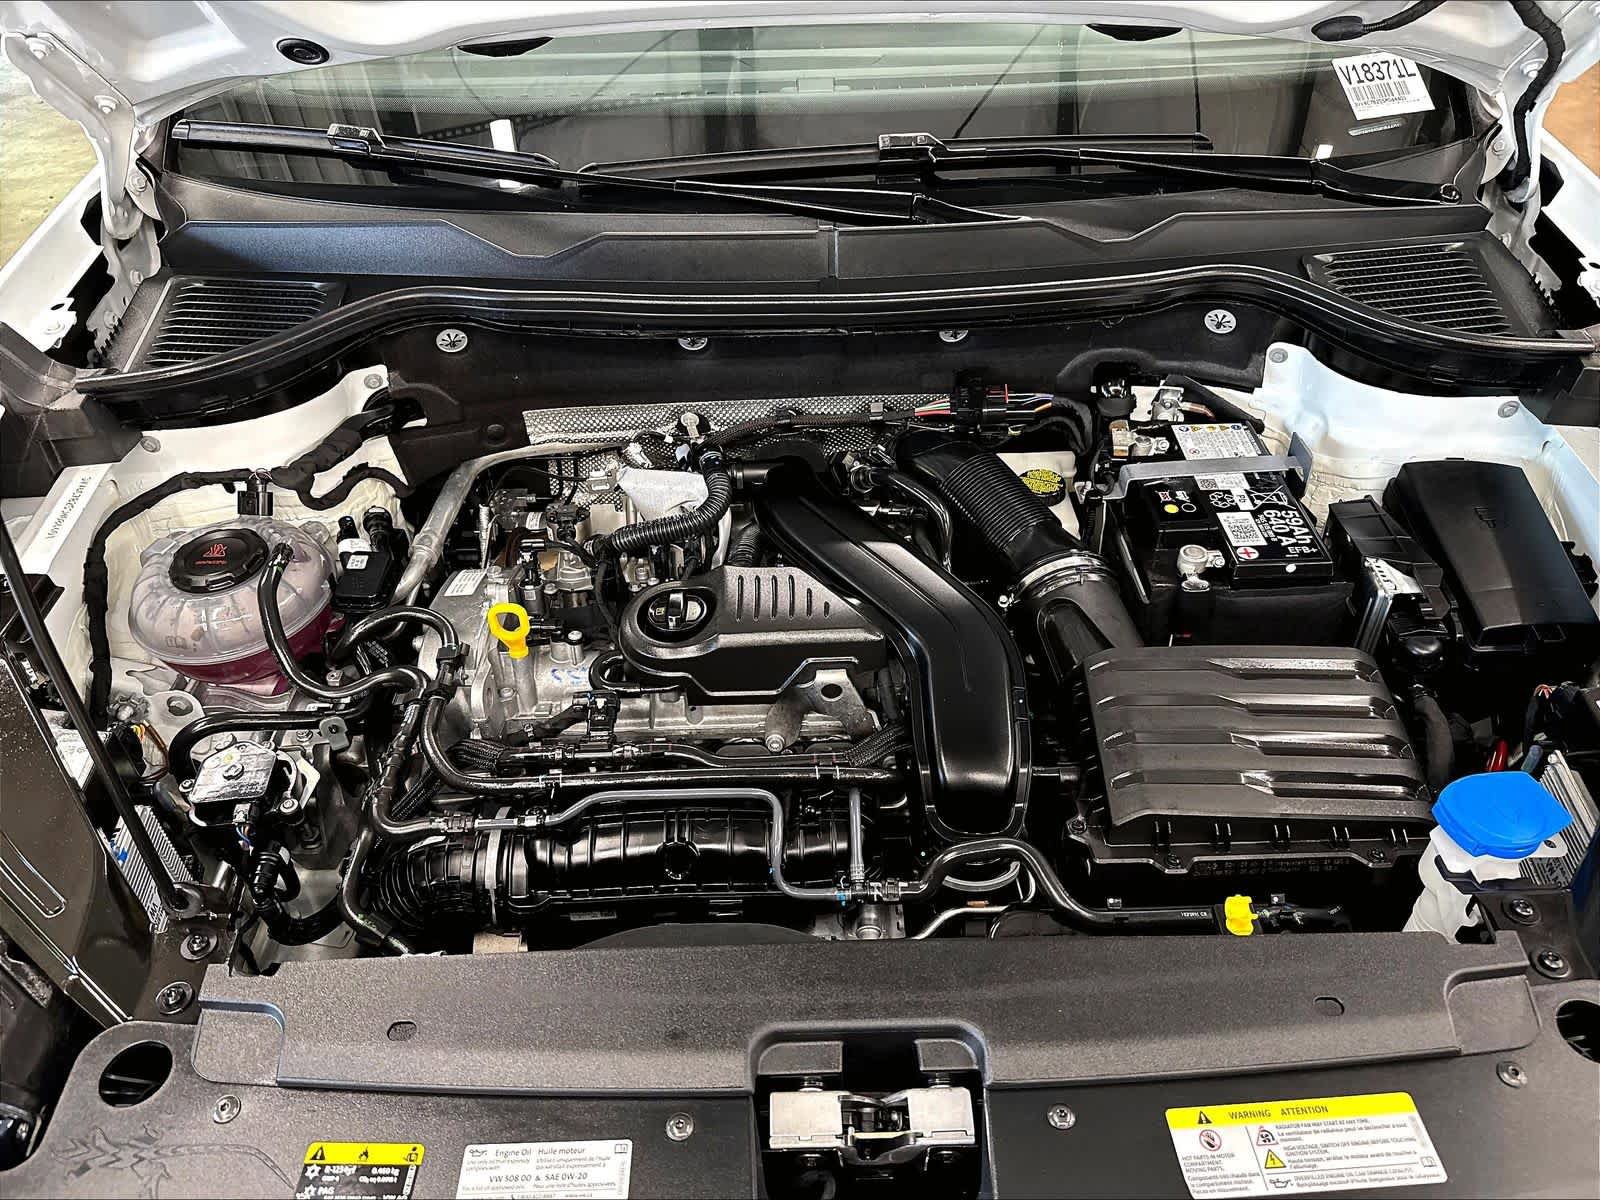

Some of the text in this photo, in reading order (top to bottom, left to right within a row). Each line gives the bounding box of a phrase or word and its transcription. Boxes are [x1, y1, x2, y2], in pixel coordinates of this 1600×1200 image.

[1338, 58, 1417, 85] V18371L
[1263, 510, 1290, 532] 640
[1281, 510, 1313, 544] 59Ah
[1276, 536, 1297, 546] A
[1228, 1106, 1328, 1120] WARNING ATTENTION
[495, 1148, 532, 1158] Engine Oil
[562, 1172, 588, 1180] 0W-20
[318, 1186, 335, 1195] PAG
